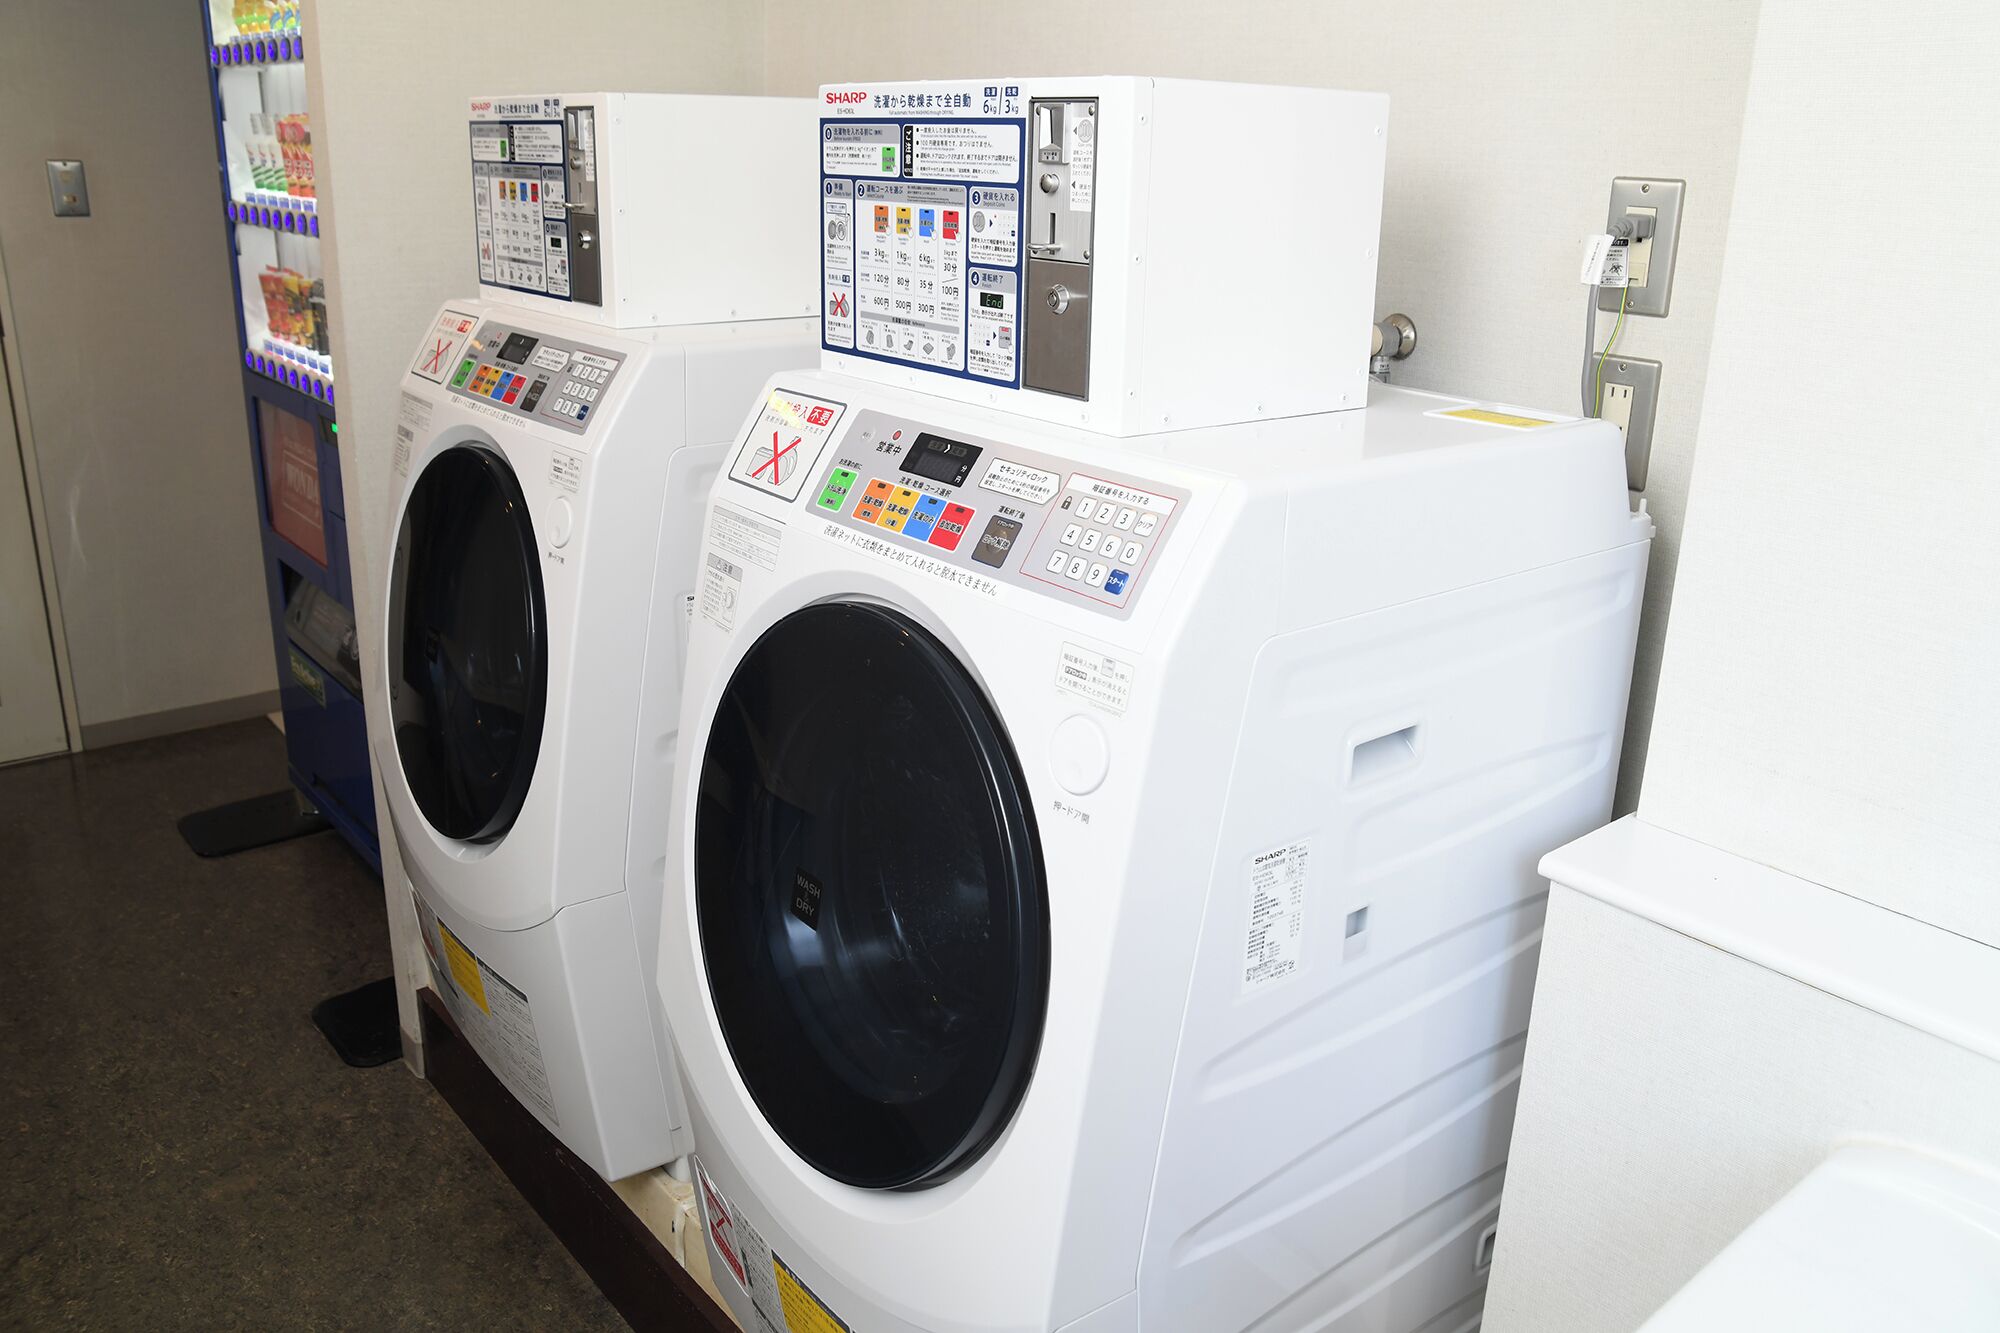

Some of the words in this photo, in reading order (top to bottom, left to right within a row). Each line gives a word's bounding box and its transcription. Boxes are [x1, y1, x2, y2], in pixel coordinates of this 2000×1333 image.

[826, 92, 867, 104] SHARP
[874, 93, 972, 109] 洗濯から乾燥まで全自動
[983, 98, 997, 114] 6kg
[1004, 98, 1018, 114] 3kg
[834, 128, 873, 136] 洗濯物を入れる前に
[866, 184, 904, 194] 運転コースを選ぶ
[983, 192, 1015, 202] 硬貨を入れる
[874, 274, 889, 284] 120分
[897, 277, 910, 287] 80分
[982, 273, 1003, 284] 運転終了
[942, 286, 959, 296] 100円
[874, 297, 889, 307] 600円
[896, 300, 911, 310] 500円
[918, 303, 934, 314] 300円
[986, 295, 1002, 308] End
[810, 408, 832, 424] 不要
[876, 441, 902, 456] 営業中
[1000, 464, 1048, 483] セキュリティロック
[1092, 483, 1150, 505] 暗証番号を入力する
[912, 511, 935, 524] 洗濯のみ
[998, 505, 1026, 520] 運転終了後
[1083, 504, 1088, 513] 1
[1100, 508, 1109, 519] 2
[1120, 514, 1128, 525] 3
[1137, 520, 1153, 530] クリア
[938, 520, 964, 534] 追加乾燥
[1067, 530, 1075, 540] 4
[1086, 534, 1094, 545] 5
[1106, 540, 1113, 552] 6
[1126, 547, 1134, 559] 0
[824, 525, 997, 596] 洗濯ネットに衣類をまとめて入れると脱水できません
[1053, 556, 1061, 567] 7
[1072, 563, 1080, 573] 8
[1092, 569, 1100, 580] 9
[1107, 575, 1125, 587] スタート
[1255, 848, 1286, 864] SHARP
[797, 874, 820, 899] WASH
[796, 898, 814, 916] DRY
